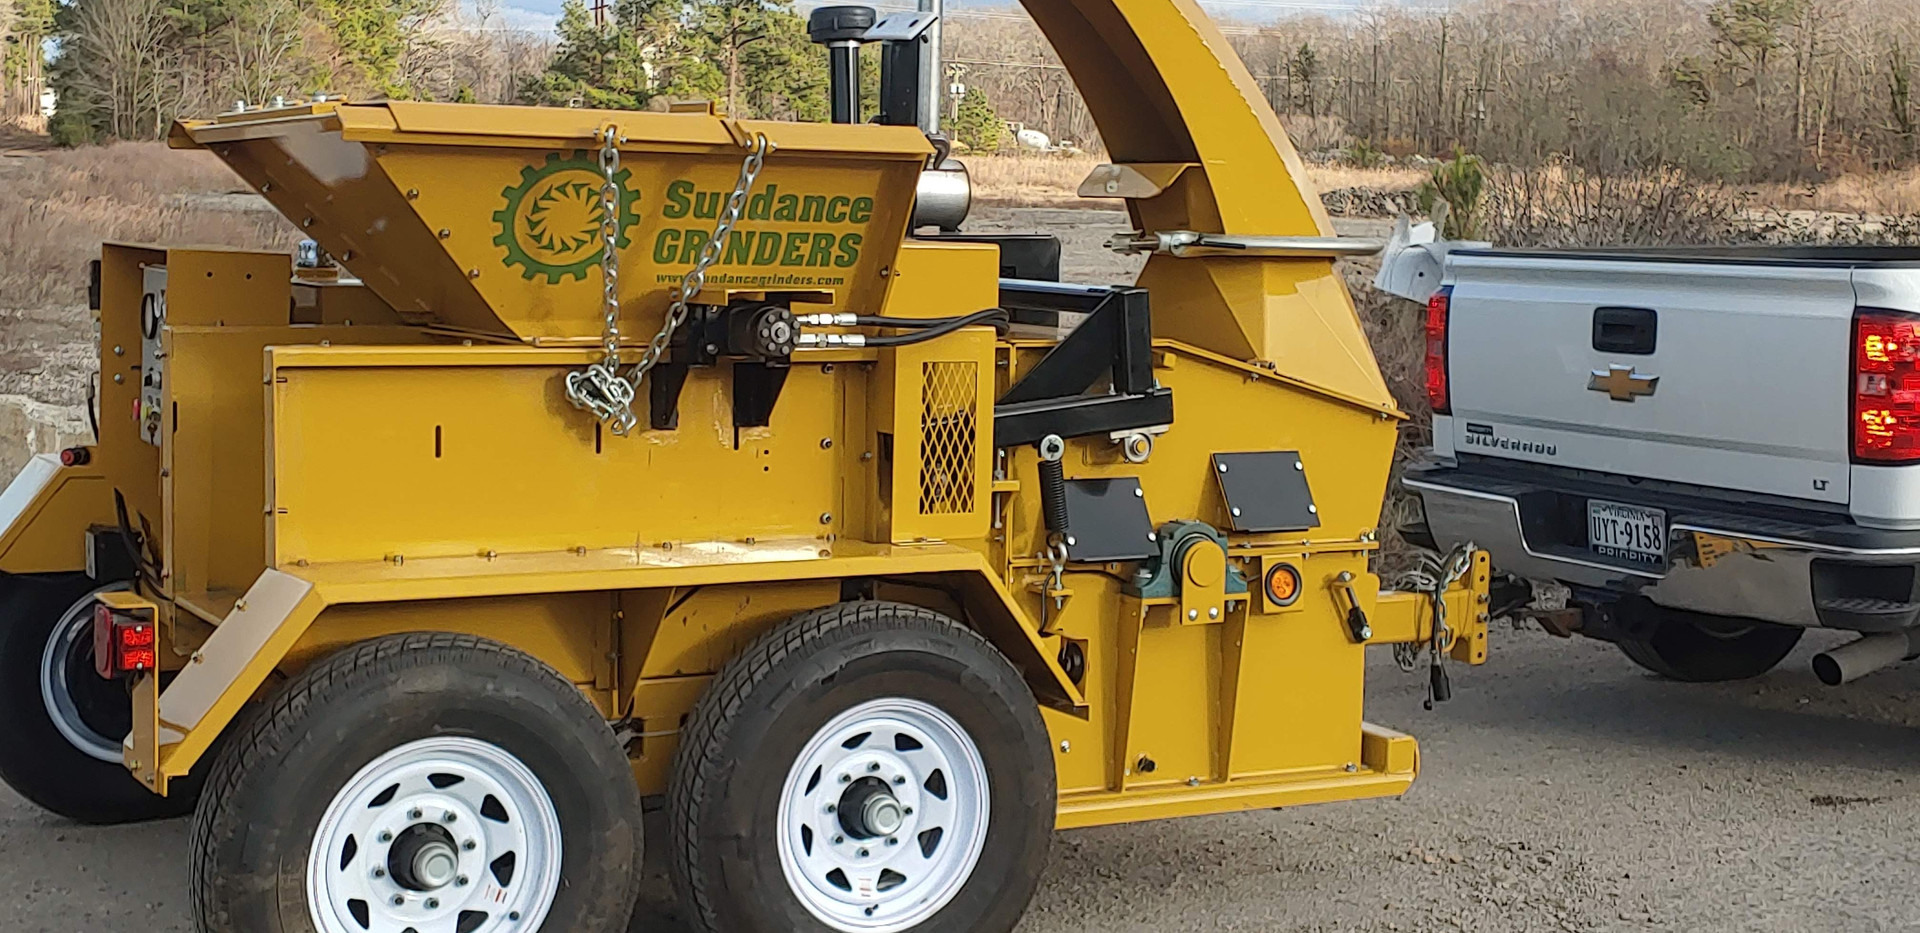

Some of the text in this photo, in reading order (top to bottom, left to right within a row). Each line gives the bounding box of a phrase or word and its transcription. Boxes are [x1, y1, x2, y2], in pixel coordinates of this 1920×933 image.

[653, 229, 863, 268] GRNDERS
[656, 273, 844, 286] wwundancegrinders.com
[1813, 479, 1830, 491] LT
[1593, 516, 1662, 551] UYT-9158
